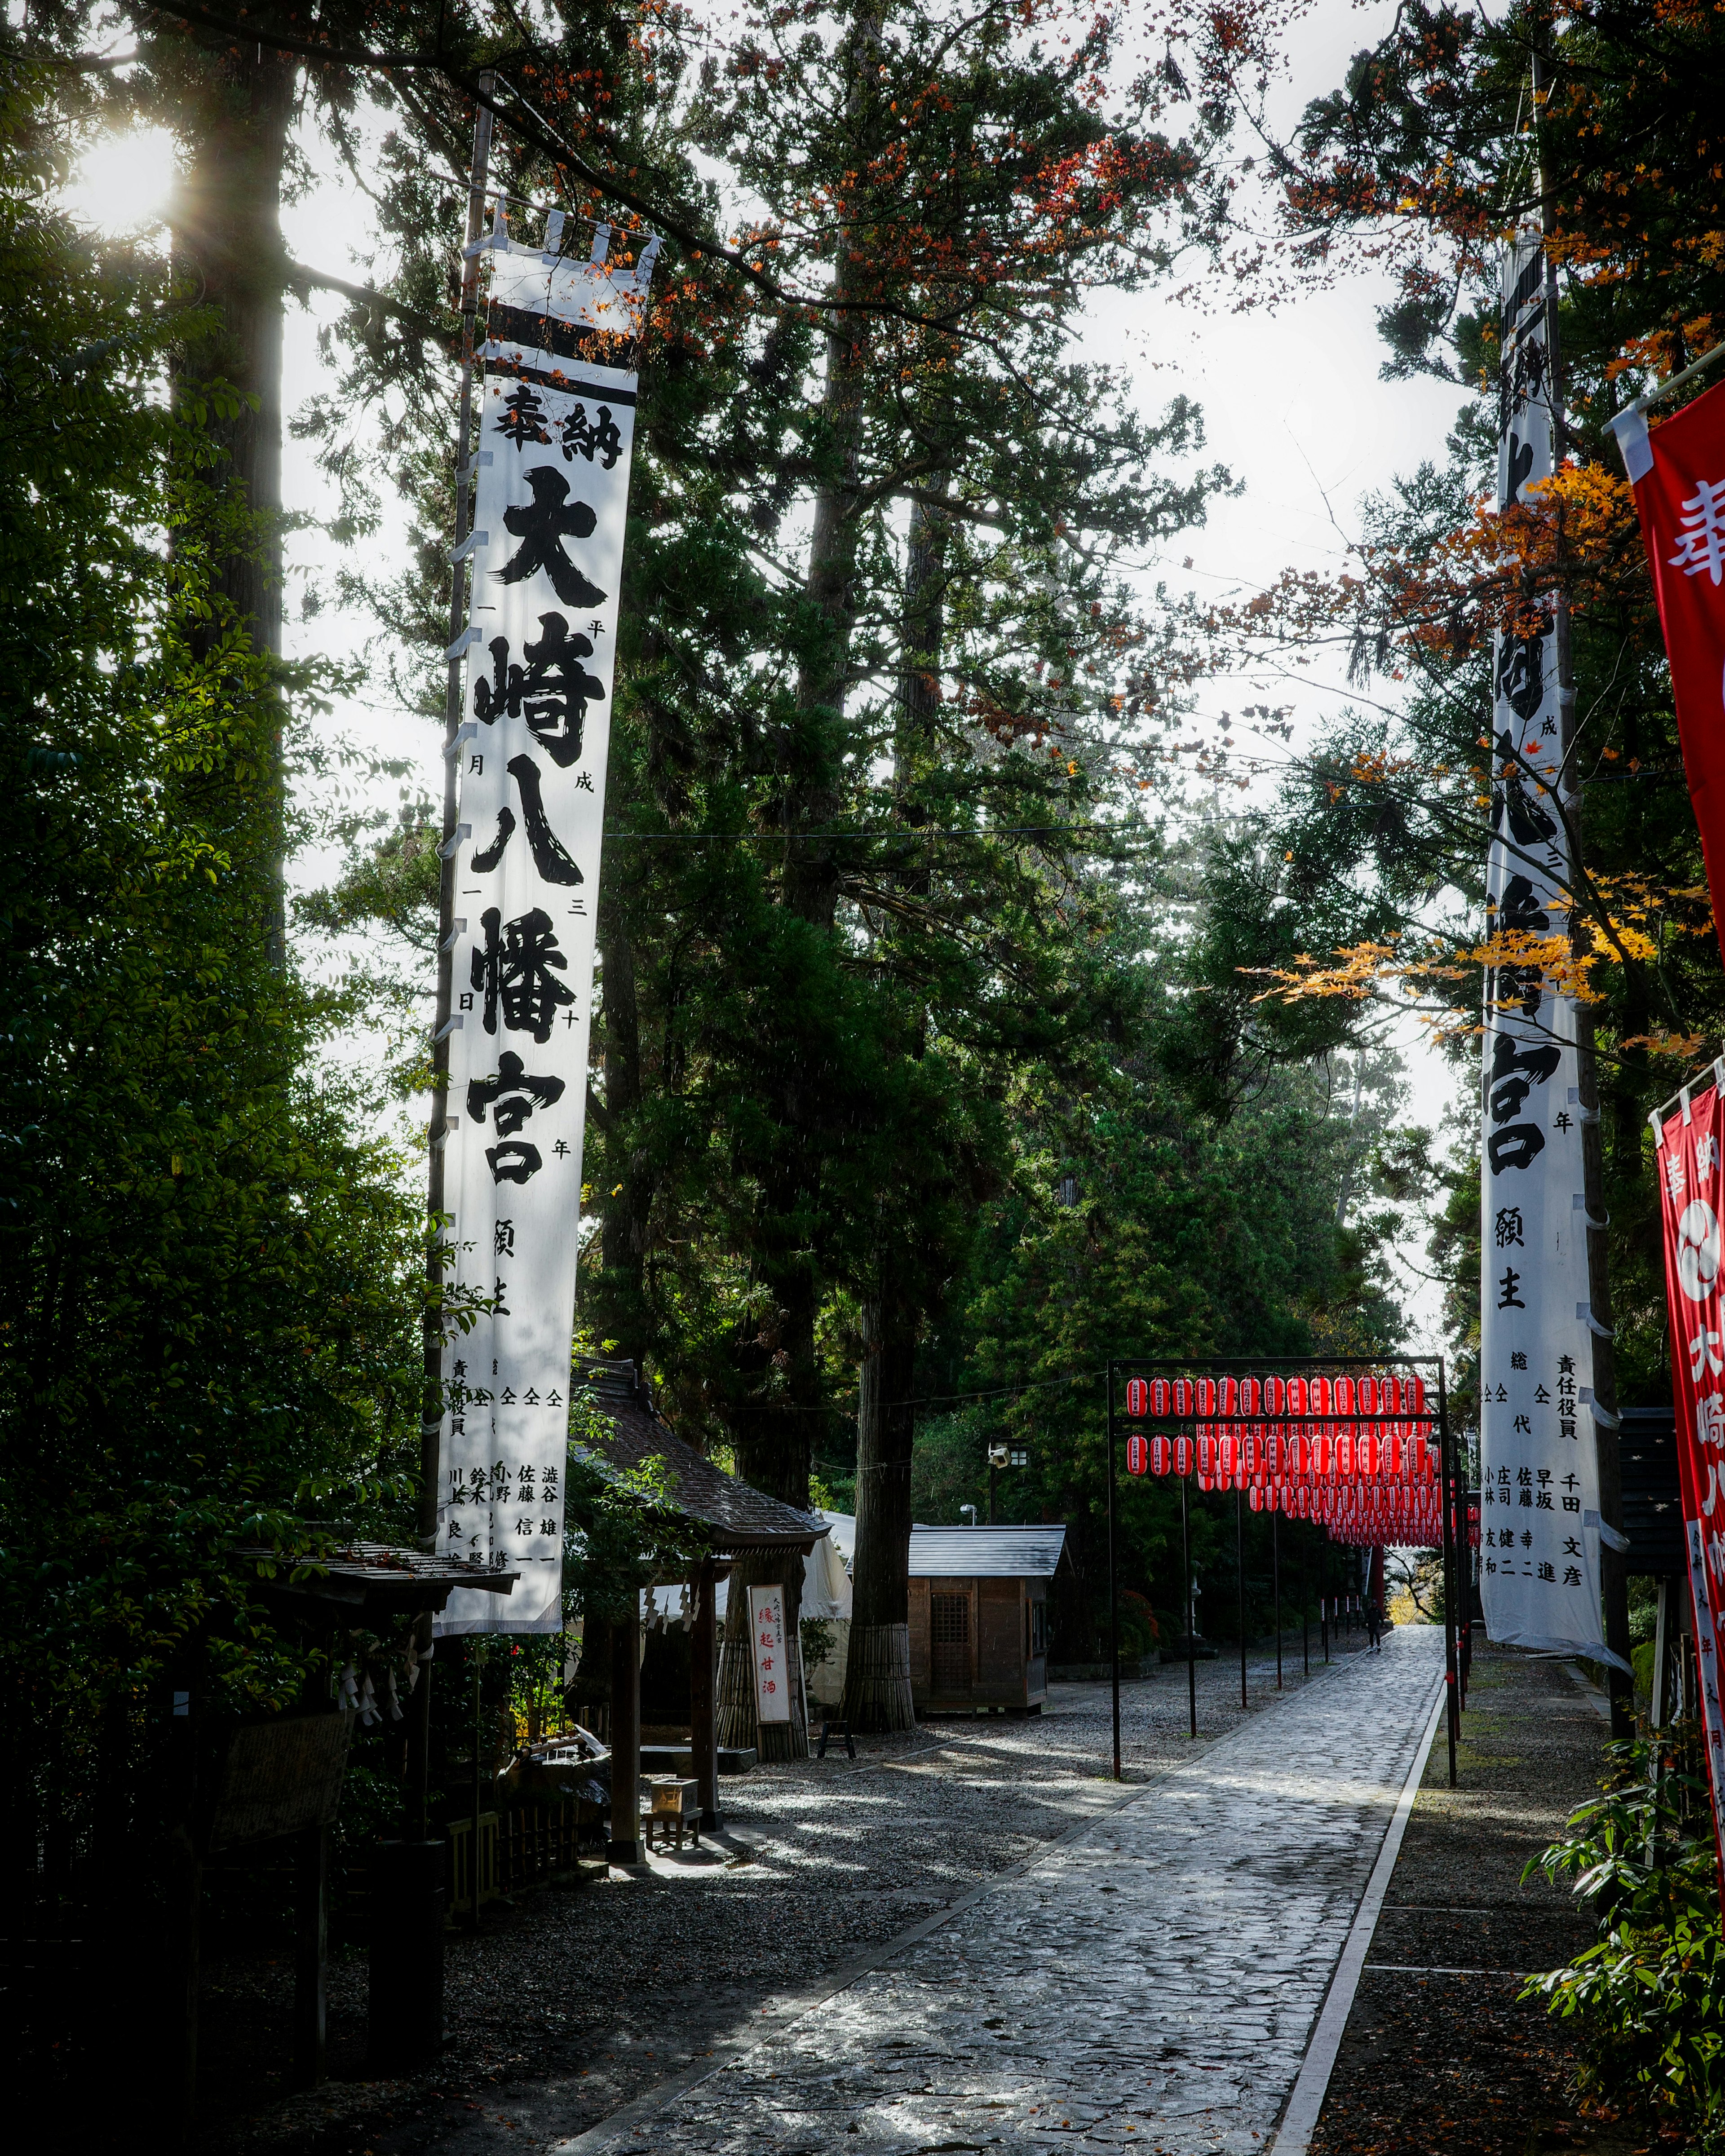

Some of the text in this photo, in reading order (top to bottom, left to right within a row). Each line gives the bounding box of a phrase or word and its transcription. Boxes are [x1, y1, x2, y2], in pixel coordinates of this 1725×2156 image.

[491, 385, 624, 470] 奉納
[467, 465, 609, 1186] 大崎八幡宮
[1666, 1131, 1721, 1206] 奉納
[1495, 1206, 1526, 1311] 願主
[1510, 1351, 1532, 1435] 総代
[1556, 1354, 1578, 1440] 責任役員
[515, 1465, 535, 1562] 佐藤信一
[1484, 1466, 1497, 1576] 小林友和
[1497, 1465, 1516, 1575] 庄司健二
[1516, 1467, 1533, 1577] 佐藤幸二
[1535, 1469, 1557, 1583] 早坂進
[758, 1607, 776, 1694] 縁起甘酒
